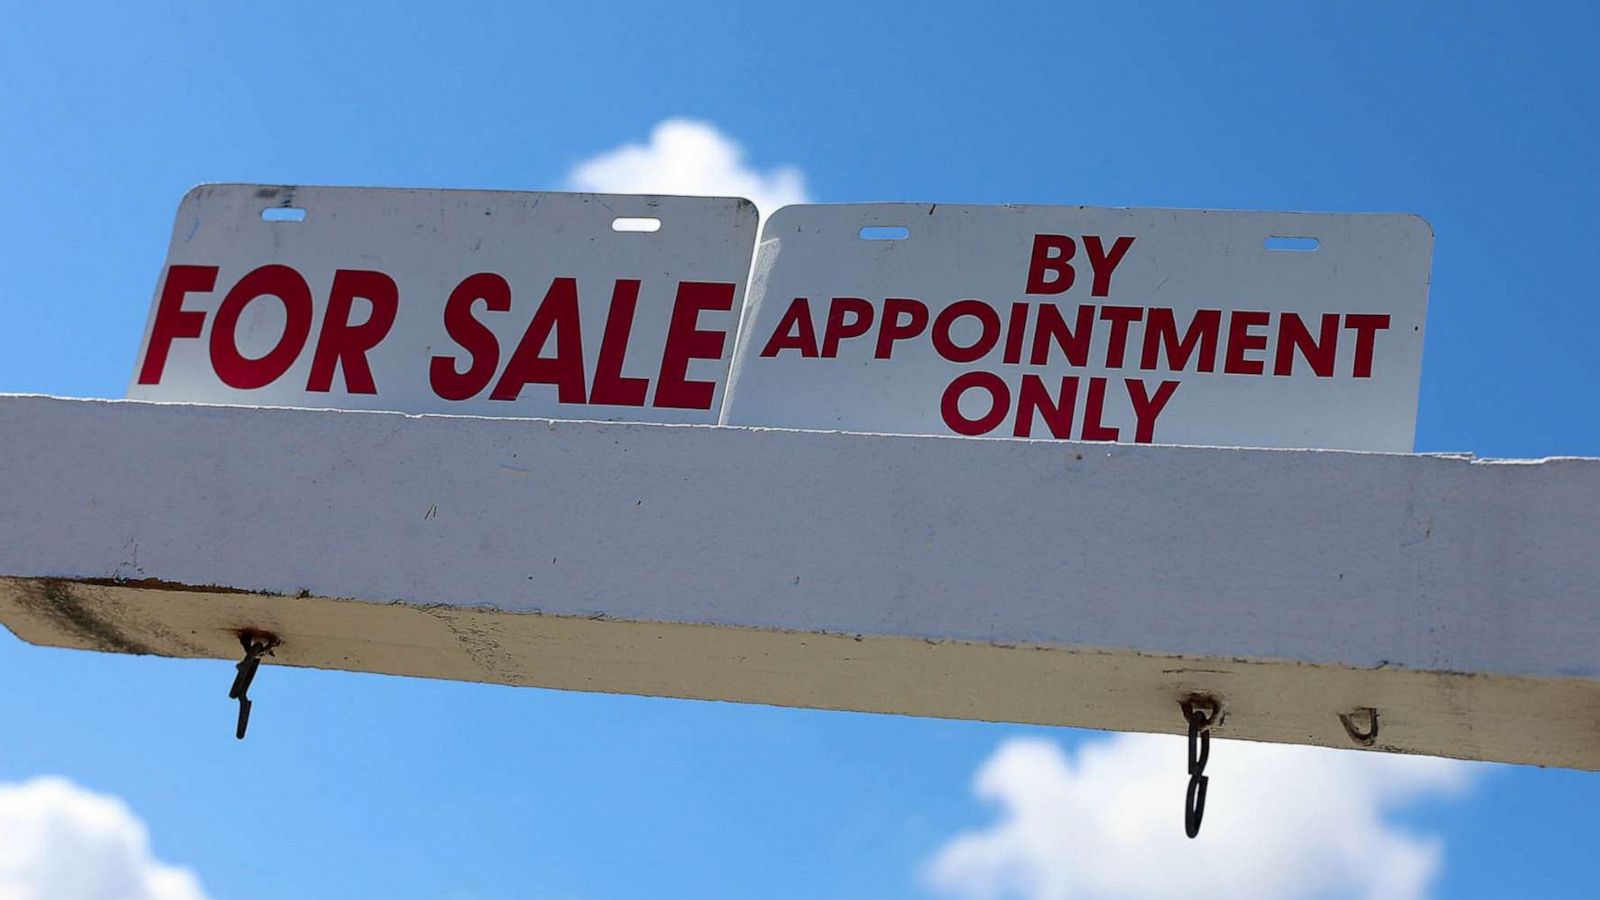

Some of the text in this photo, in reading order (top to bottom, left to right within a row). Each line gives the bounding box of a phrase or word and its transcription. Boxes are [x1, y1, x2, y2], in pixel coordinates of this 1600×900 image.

[1026, 234, 1135, 296] BY
[138, 264, 736, 409] FOR SALE
[761, 297, 1391, 378] APPOINTMENT
[940, 371, 1180, 443] ONLY
